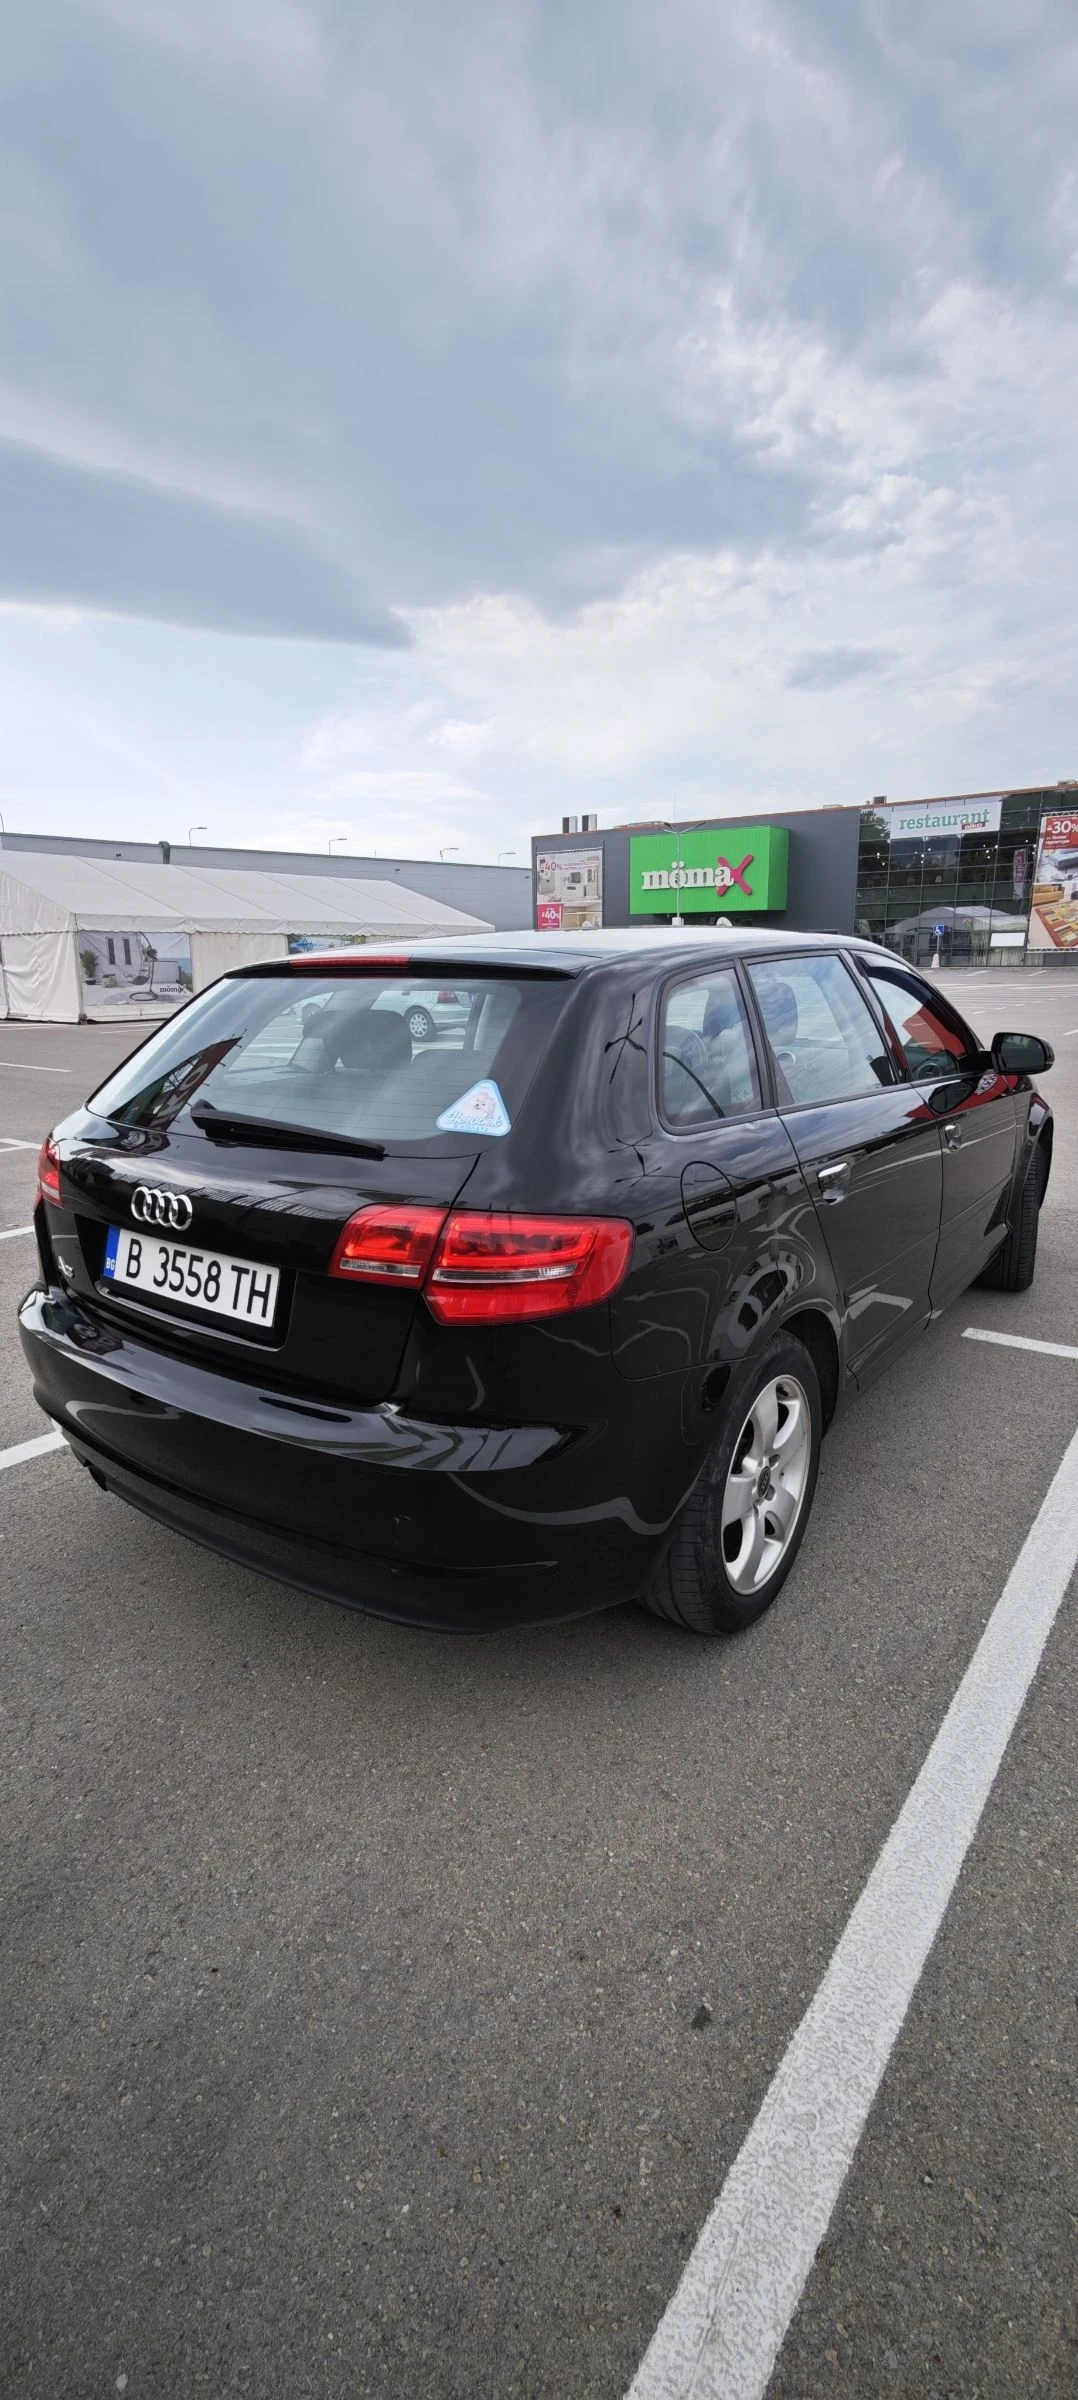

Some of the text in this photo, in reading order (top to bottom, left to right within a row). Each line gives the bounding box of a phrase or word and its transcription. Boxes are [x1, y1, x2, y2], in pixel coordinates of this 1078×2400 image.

[900, 809, 990, 830] restaurant
[1047, 820, 1078, 834] -30%
[105, 1257, 116, 1271] BG
[125, 1237, 273, 1318] B 3558 TH
